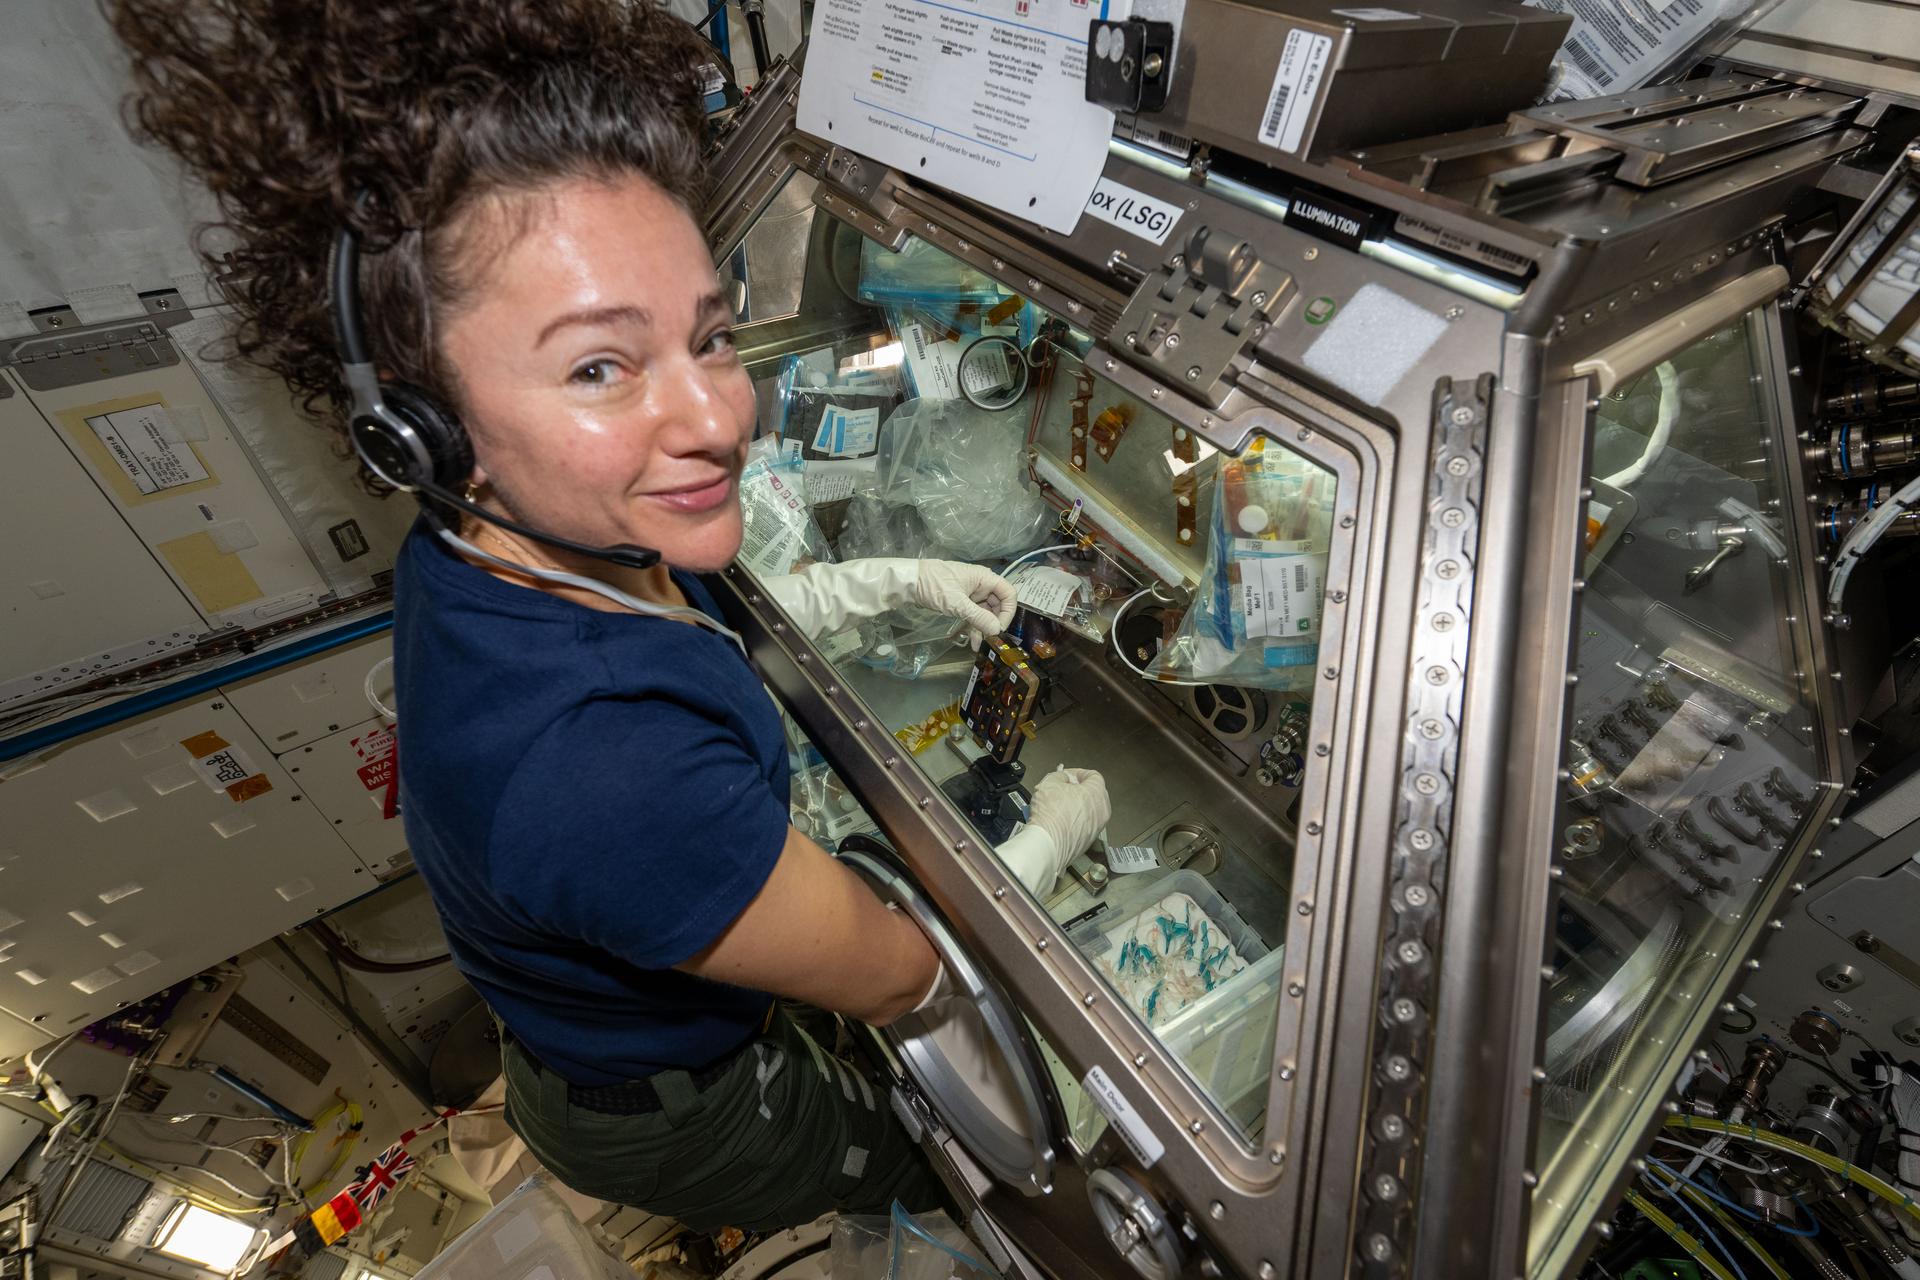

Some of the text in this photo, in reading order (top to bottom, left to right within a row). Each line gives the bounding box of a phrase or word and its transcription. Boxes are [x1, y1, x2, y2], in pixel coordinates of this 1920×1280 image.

[1000, 37, 1012, 45] Media
[1013, 42, 1028, 50] syringe
[1001, 29, 1013, 37] Waste
[1013, 34, 1028, 42] syringe
[1314, 39, 1326, 60] Fan
[987, 50, 1000, 59] Repeat
[1030, 62, 1043, 70] Media
[989, 60, 1003, 68] syringe
[1004, 64, 1016, 72] empty
[1025, 69, 1037, 77] Waste
[989, 68, 1003, 76] syringe
[867, 115, 883, 125] Repeat
[904, 128, 919, 138] Rotate
[945, 144, 961, 153] repeat
[985, 158, 995, 166] and
[1091, 192, 1172, 240] ox (LSG)
[1293, 200, 1360, 236] ILLUMINATION
[1400, 212, 1441, 234] Light Panel
[367, 761, 391, 774] WA
[367, 771, 390, 785] MIS
[1091, 1070, 1124, 1112] Main Door
